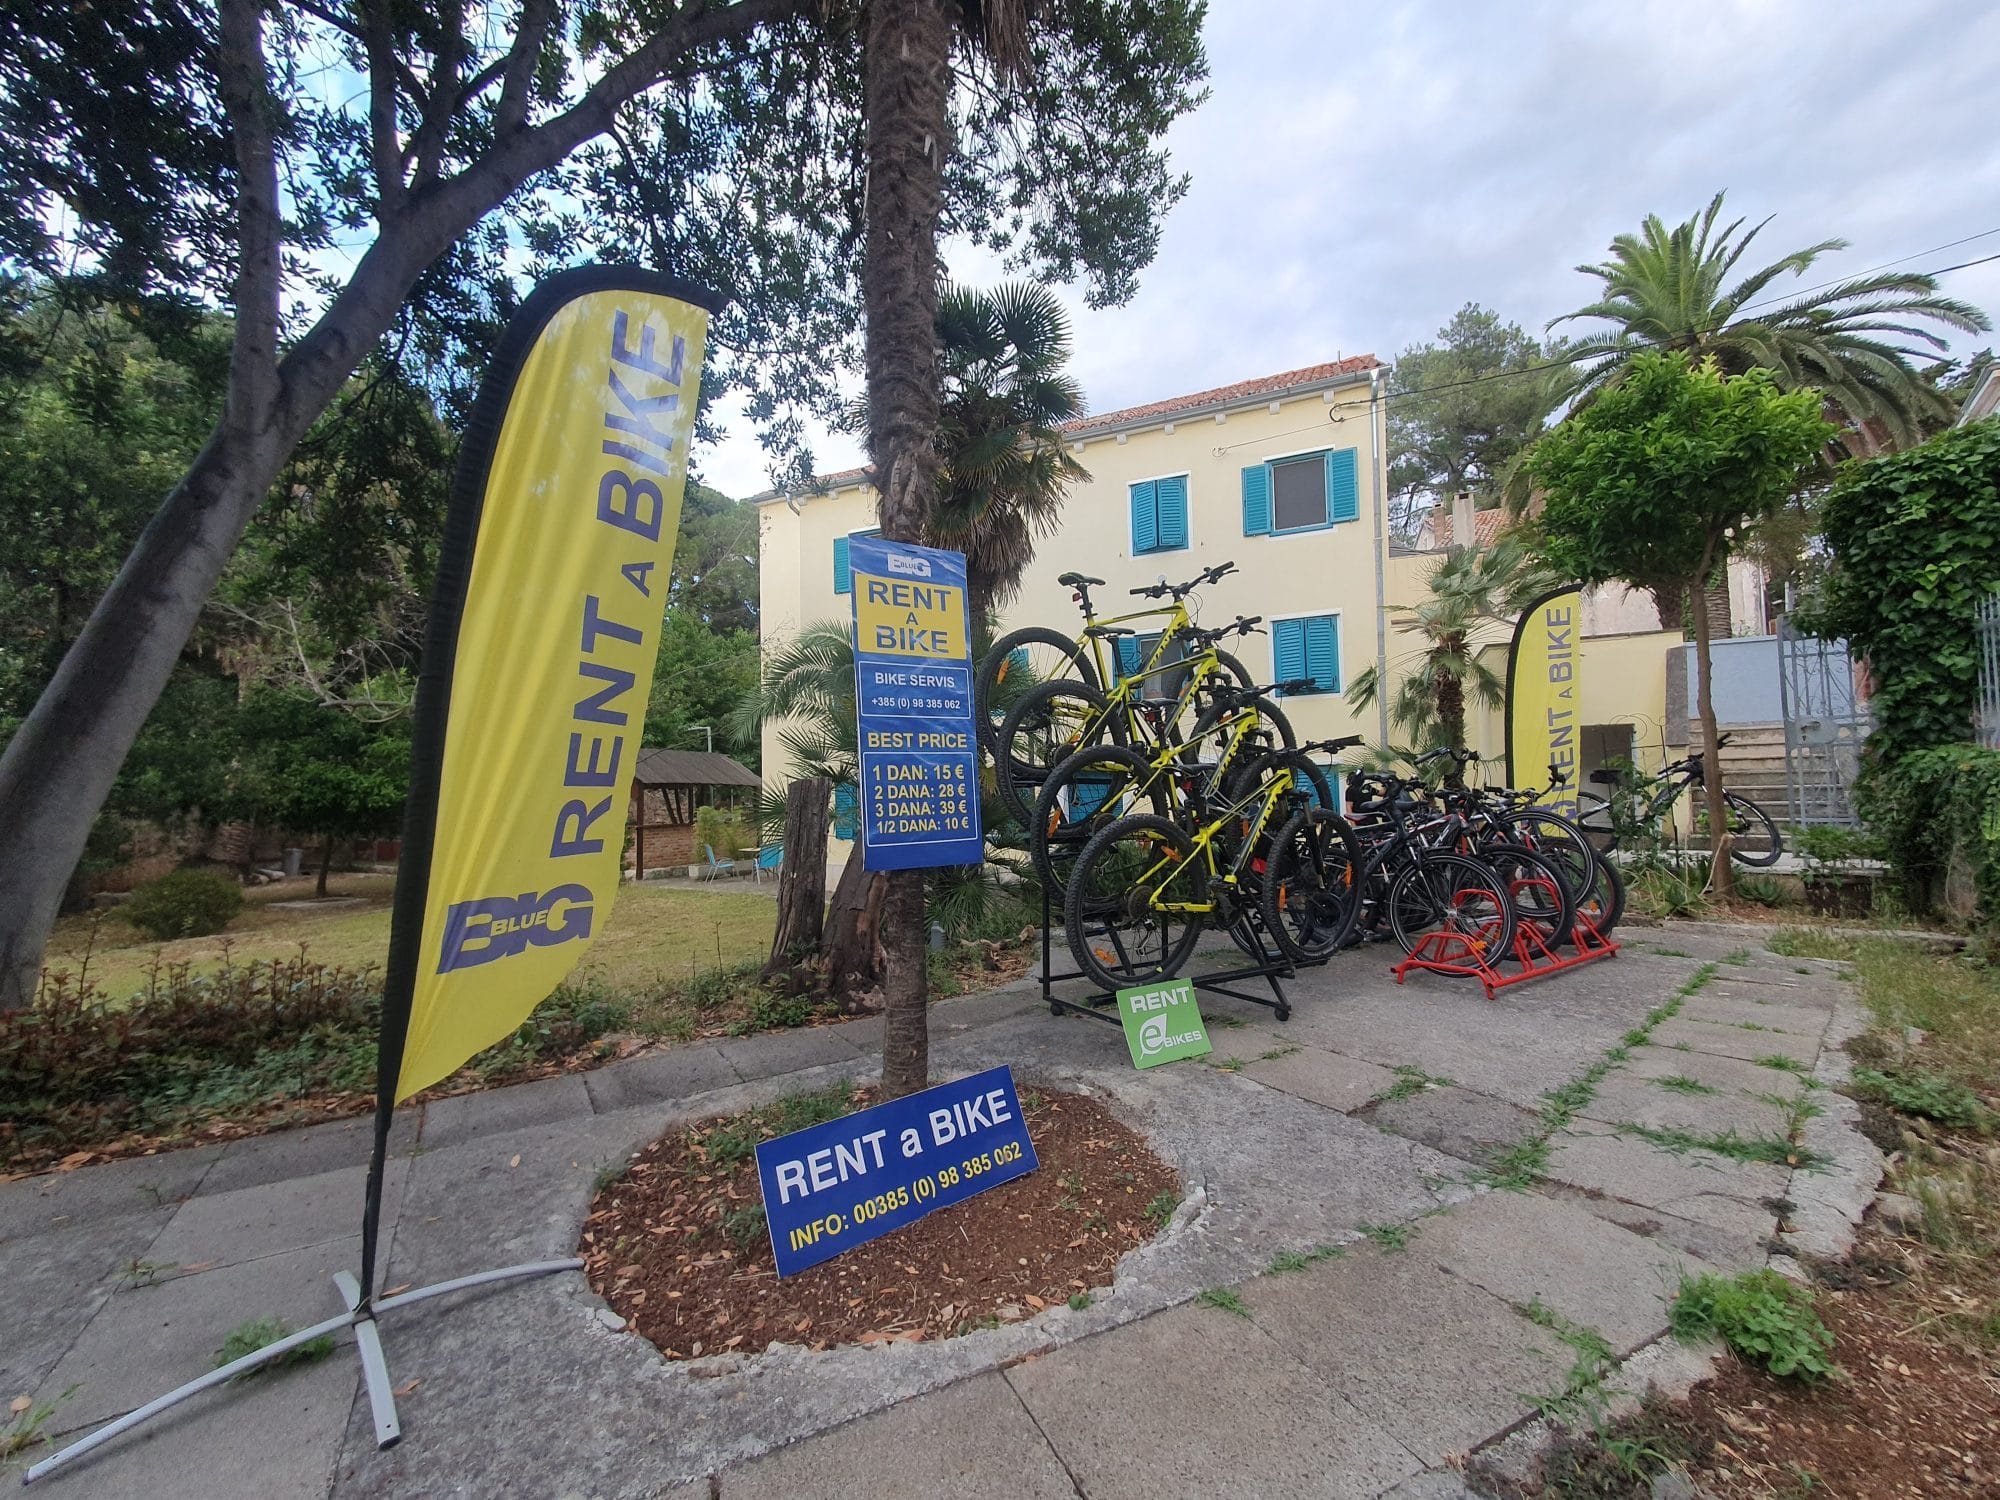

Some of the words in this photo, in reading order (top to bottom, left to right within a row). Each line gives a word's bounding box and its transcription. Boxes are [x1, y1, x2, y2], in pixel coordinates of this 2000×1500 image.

[596, 309, 686, 543] BIKE
[621, 561, 655, 598] A
[868, 580, 951, 612] RENT
[905, 612, 919, 626] A
[876, 625, 949, 654] BIKE
[1546, 606, 1572, 684] BIKE
[875, 672, 906, 686] BIKE
[910, 674, 955, 688] SERVIS
[1558, 686, 1573, 699] A
[872, 697, 895, 707] +385
[898, 698, 910, 709] (0)
[913, 699, 924, 708] 98
[926, 699, 942, 709] 385
[945, 700, 961, 709] 062
[550, 595, 643, 858] RENT
[868, 732, 913, 748] BEST
[919, 733, 967, 748] PRICE
[873, 765, 881, 781] 1
[887, 765, 929, 781] DAN:
[934, 765, 951, 780] 15
[955, 764, 964, 780] €
[874, 785, 883, 800] 2
[888, 785, 934, 799] DANA:
[939, 783, 954, 798] 28
[957, 783, 966, 797] €
[875, 803, 884, 817] 3
[889, 802, 935, 817] DANA:
[939, 801, 955, 815] 39
[959, 800, 967, 814] €
[876, 821, 896, 834] 1/2
[900, 819, 941, 833] DANA:
[944, 818, 958, 830] 10
[961, 817, 969, 829] €
[436, 883, 594, 974] BIG
[490, 909, 548, 937] BLUE
[1130, 986, 1190, 1013] RENT
[775, 1129, 887, 1204] RENT
[900, 1127, 923, 1158] a
[929, 1088, 1012, 1146] BIKE
[789, 1213, 849, 1251] INFO:
[853, 1186, 909, 1224] 00385
[912, 1175, 936, 1204] (0)
[938, 1166, 960, 1189] 98
[964, 1153, 992, 1179] 385
[994, 1141, 1022, 1167] 062
